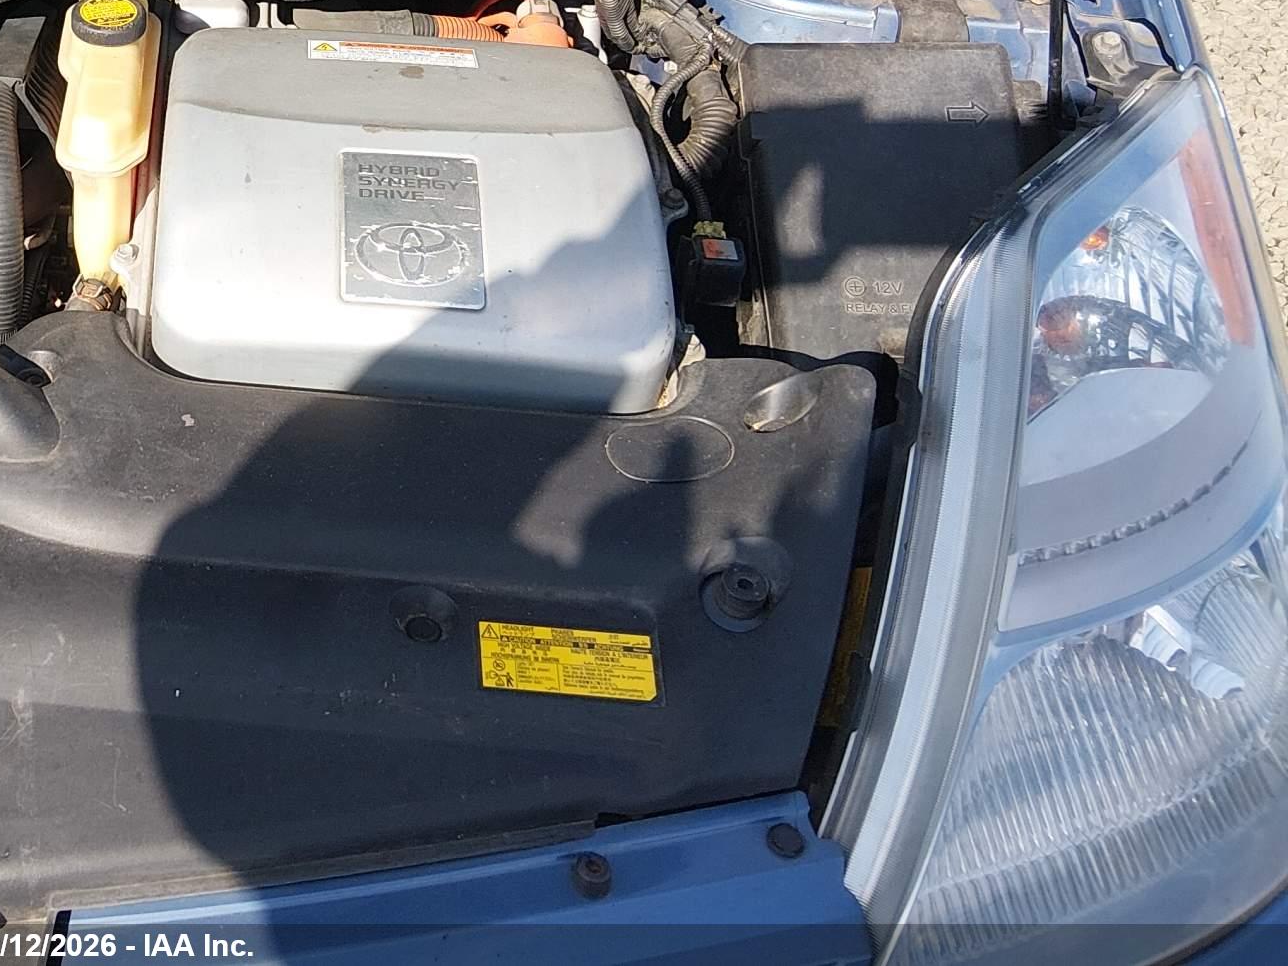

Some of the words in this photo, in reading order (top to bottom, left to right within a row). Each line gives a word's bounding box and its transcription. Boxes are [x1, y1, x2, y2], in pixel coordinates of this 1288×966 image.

[358, 164, 440, 177] HYBRID
[359, 176, 460, 191] SYNERGY
[359, 188, 425, 202] DRIVE
[873, 281, 903, 295] 12V
[845, 303, 886, 314] RELAY
[887, 304, 899, 314] &
[509, 636, 536, 644] CAUTION
